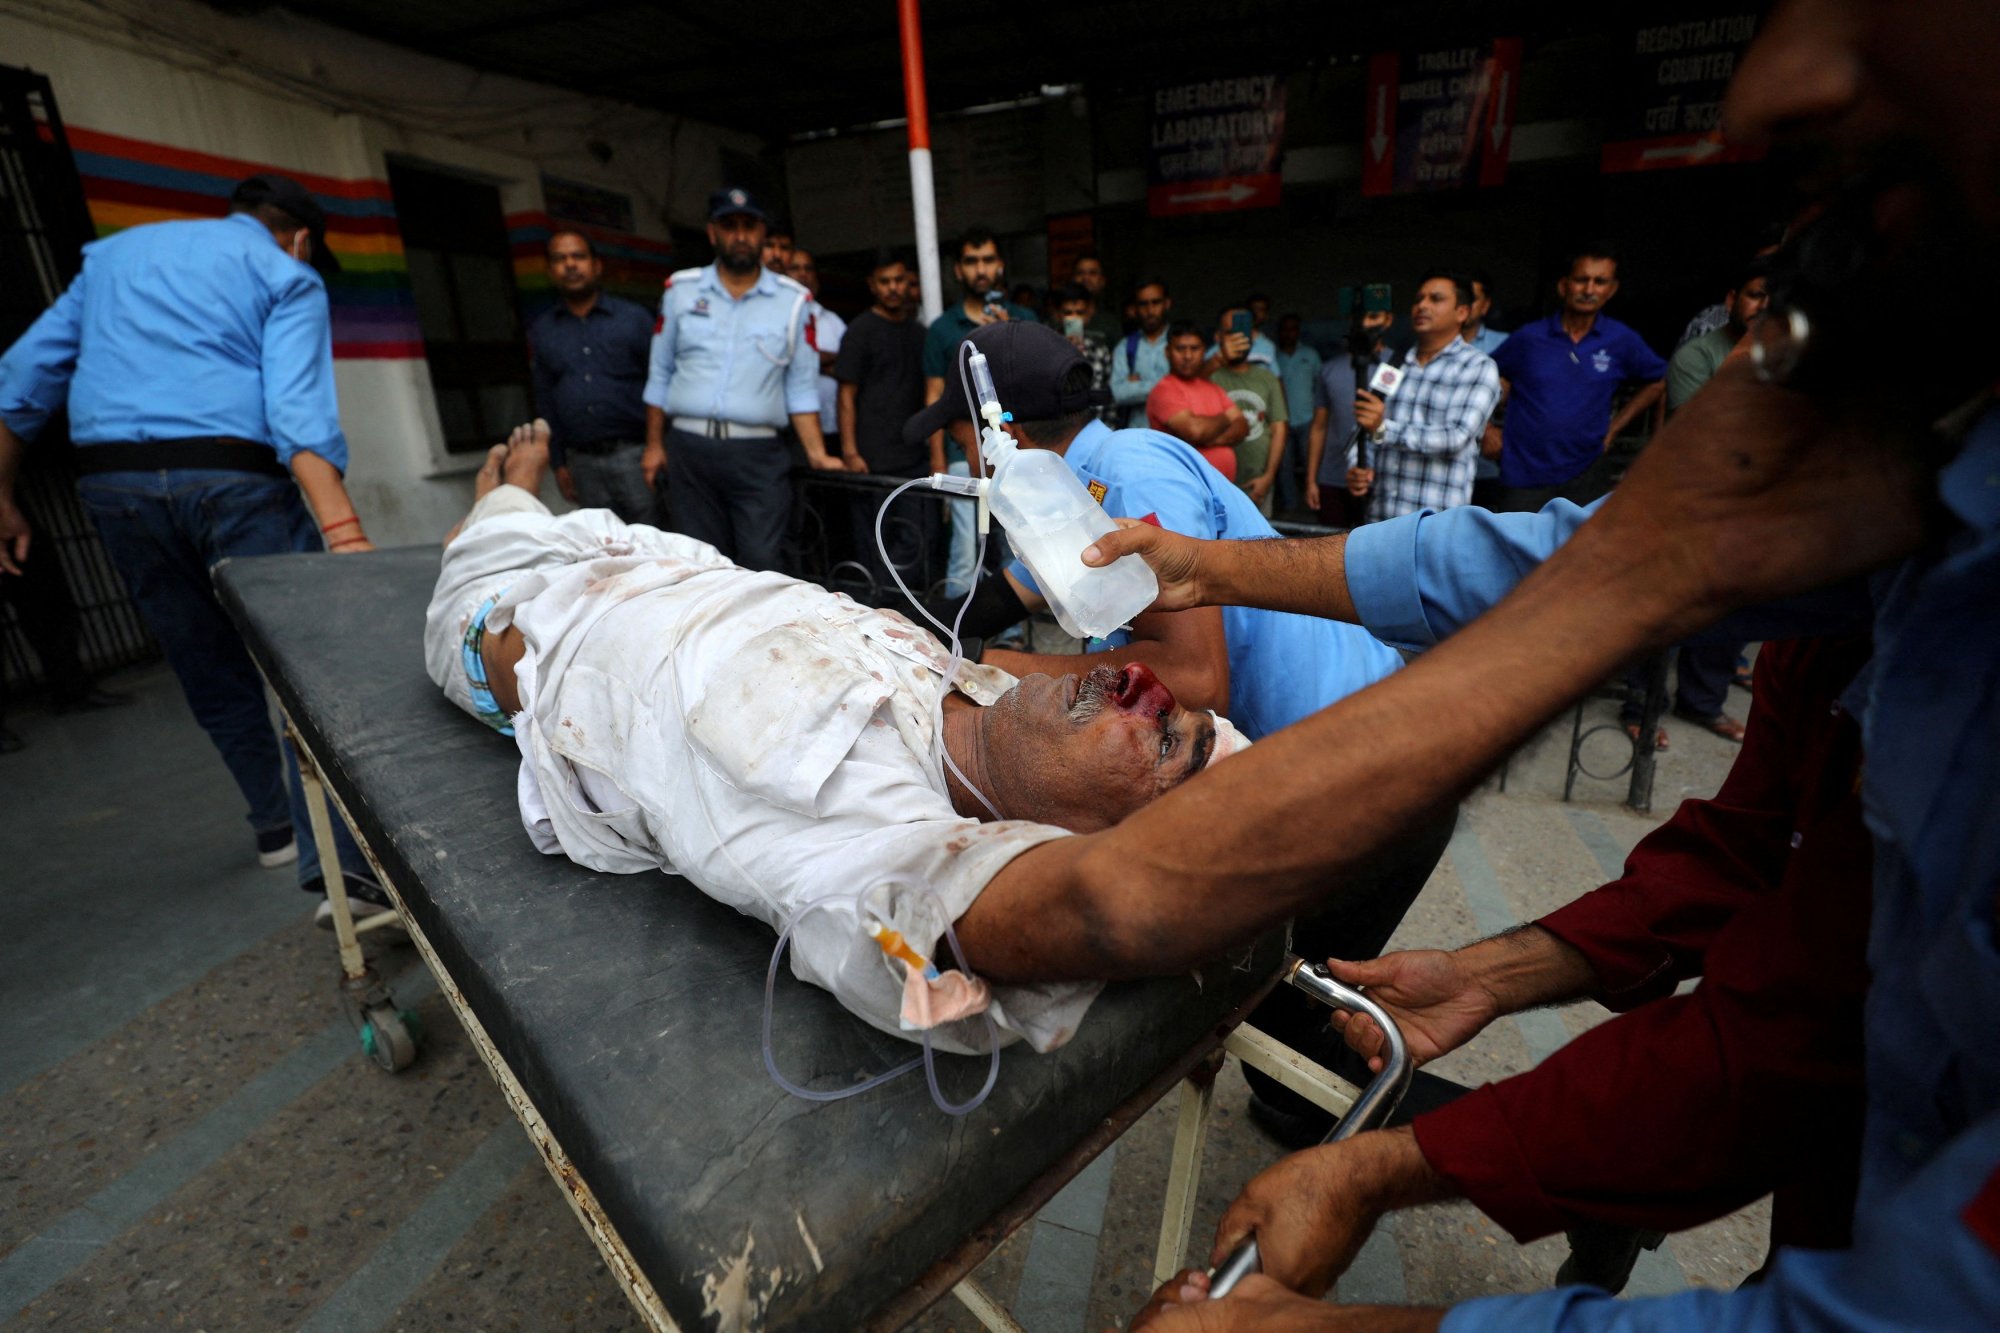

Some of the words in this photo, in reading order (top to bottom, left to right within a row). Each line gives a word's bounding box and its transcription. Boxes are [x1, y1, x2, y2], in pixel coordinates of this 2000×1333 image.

[1636, 13, 1757, 54] REGISTRATION
[1658, 51, 1734, 86] COUNTER
[1155, 74, 1276, 115] EMERGENCY
[1151, 109, 1278, 148] LABORATORY
